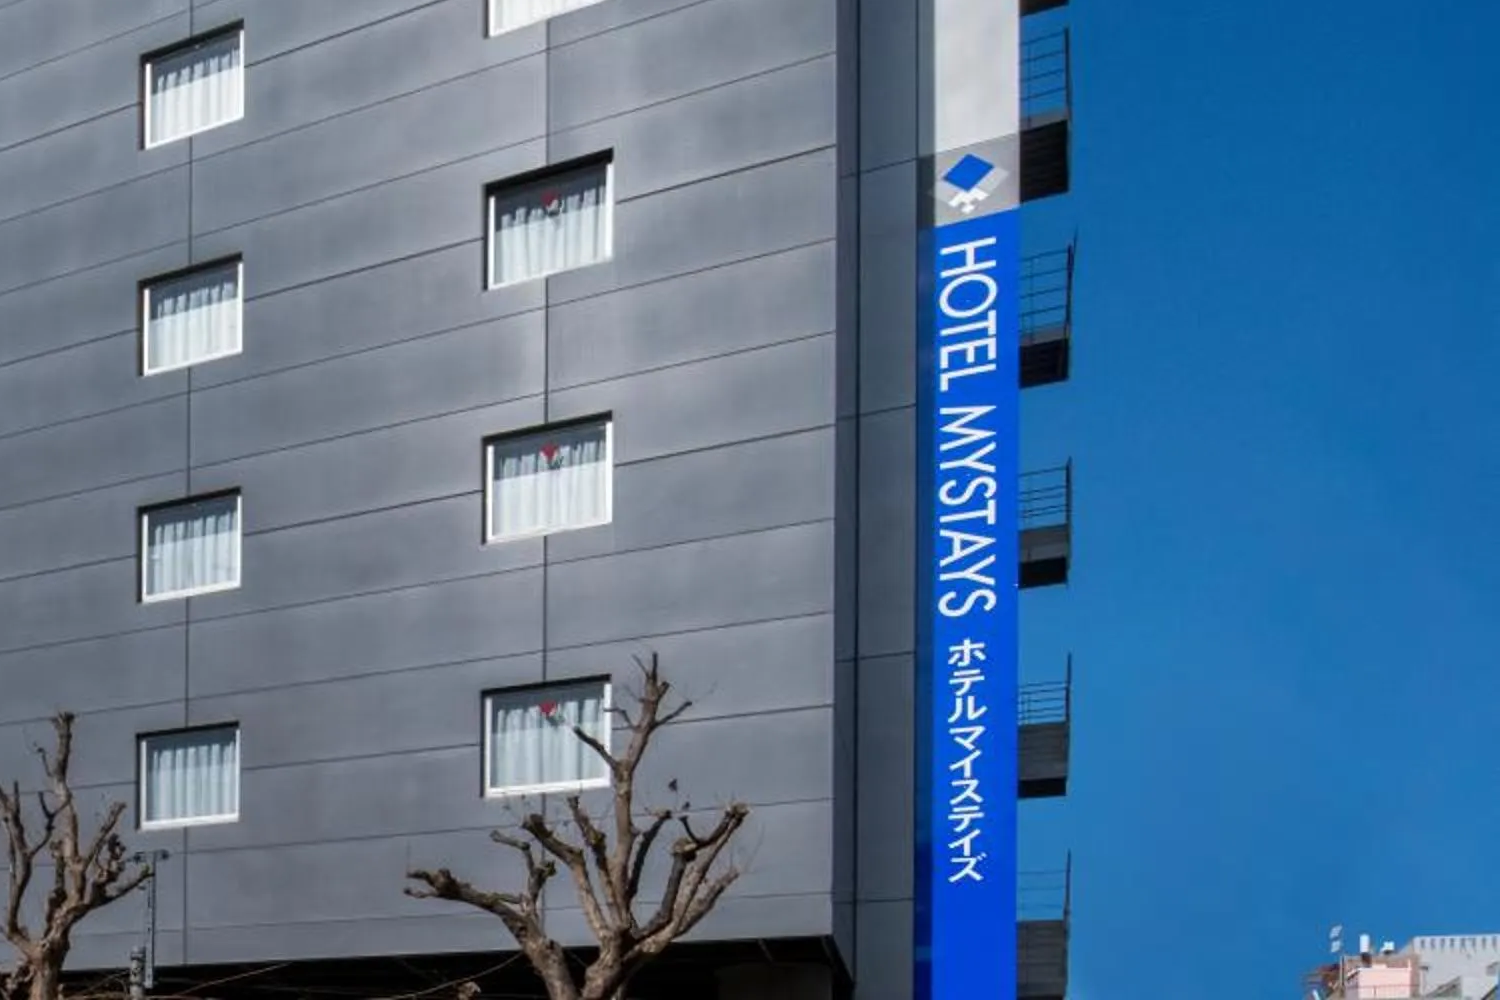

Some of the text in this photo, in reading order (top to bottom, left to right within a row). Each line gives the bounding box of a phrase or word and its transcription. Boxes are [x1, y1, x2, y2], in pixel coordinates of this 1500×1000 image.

[938, 236, 997, 618] HOTEL MYSTAYS
[949, 638, 987, 883] ホテルマイステイズ
